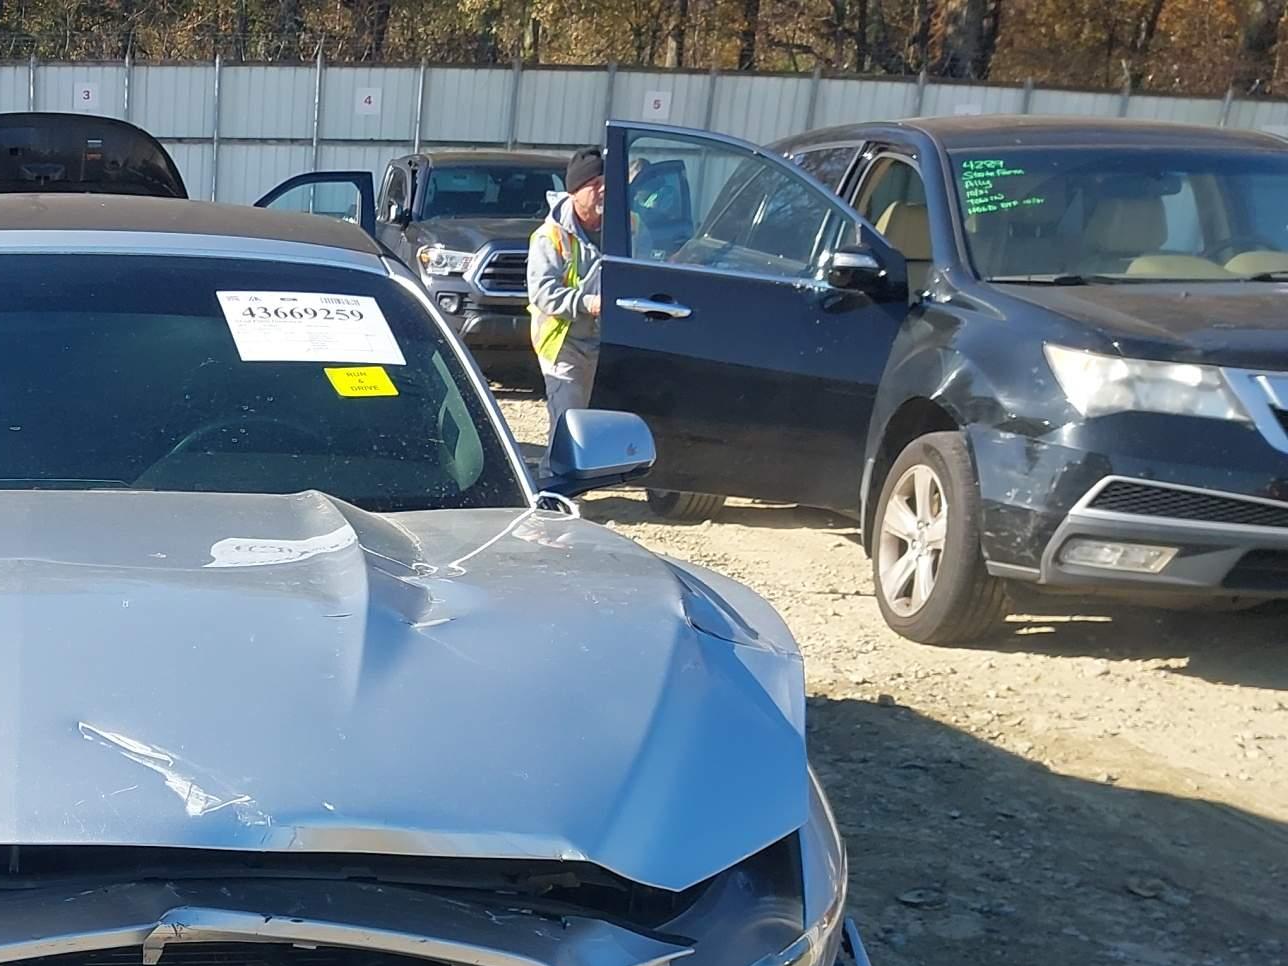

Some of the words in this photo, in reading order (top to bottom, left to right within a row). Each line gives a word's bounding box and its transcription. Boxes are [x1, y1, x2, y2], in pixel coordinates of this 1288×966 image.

[82, 90, 91, 101] 3
[363, 95, 373, 106] 4
[652, 99, 662, 110] 5
[242, 306, 364, 322] 43669259
[350, 384, 380, 392] DRIVE
